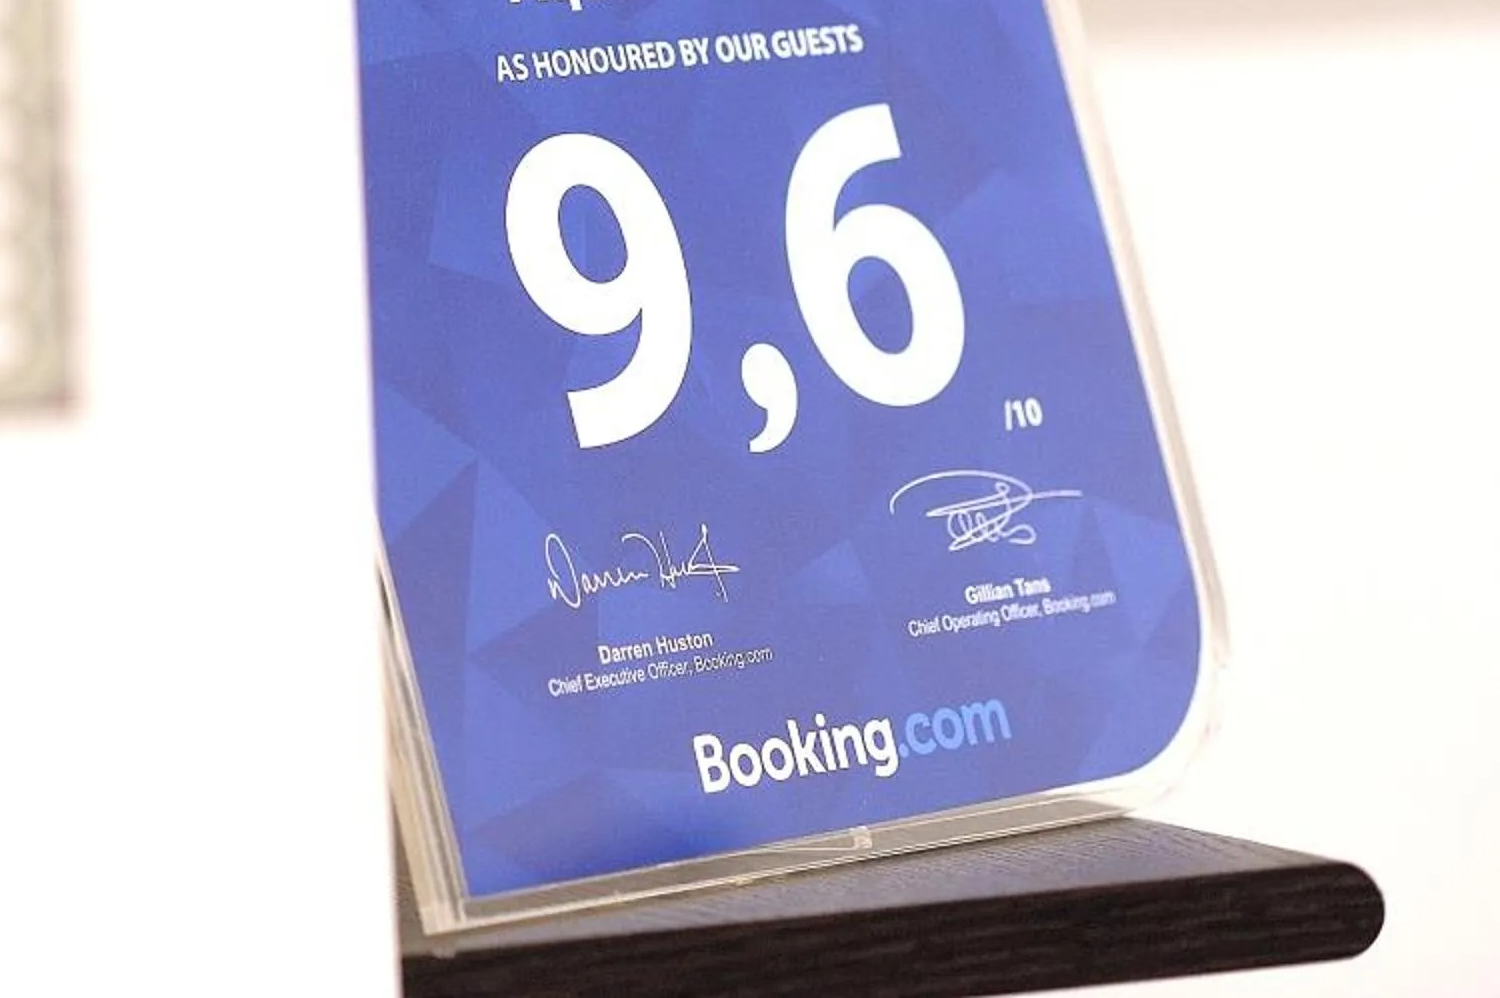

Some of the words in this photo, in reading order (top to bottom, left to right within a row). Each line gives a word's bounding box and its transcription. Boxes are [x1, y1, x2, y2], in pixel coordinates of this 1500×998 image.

[497, 53, 528, 82] AS
[531, 41, 675, 78] HONOURED
[678, 37, 709, 66] BY
[714, 33, 770, 62] OUR
[772, 24, 863, 58] GUESTS
[505, 103, 965, 453] 9,6
[1003, 397, 1043, 431] /10
[963, 583, 1013, 604] Gillian
[1014, 577, 1051, 597] Tans
[908, 617, 941, 637] Chief
[942, 607, 1000, 632] Operating
[597, 640, 653, 664] Darren
[655, 631, 712, 655] Huston
[547, 673, 583, 697] Chief
[584, 667, 646, 691] Executive
[694, 647, 773, 672] Booking.com
[692, 698, 1012, 794] Booking.com
